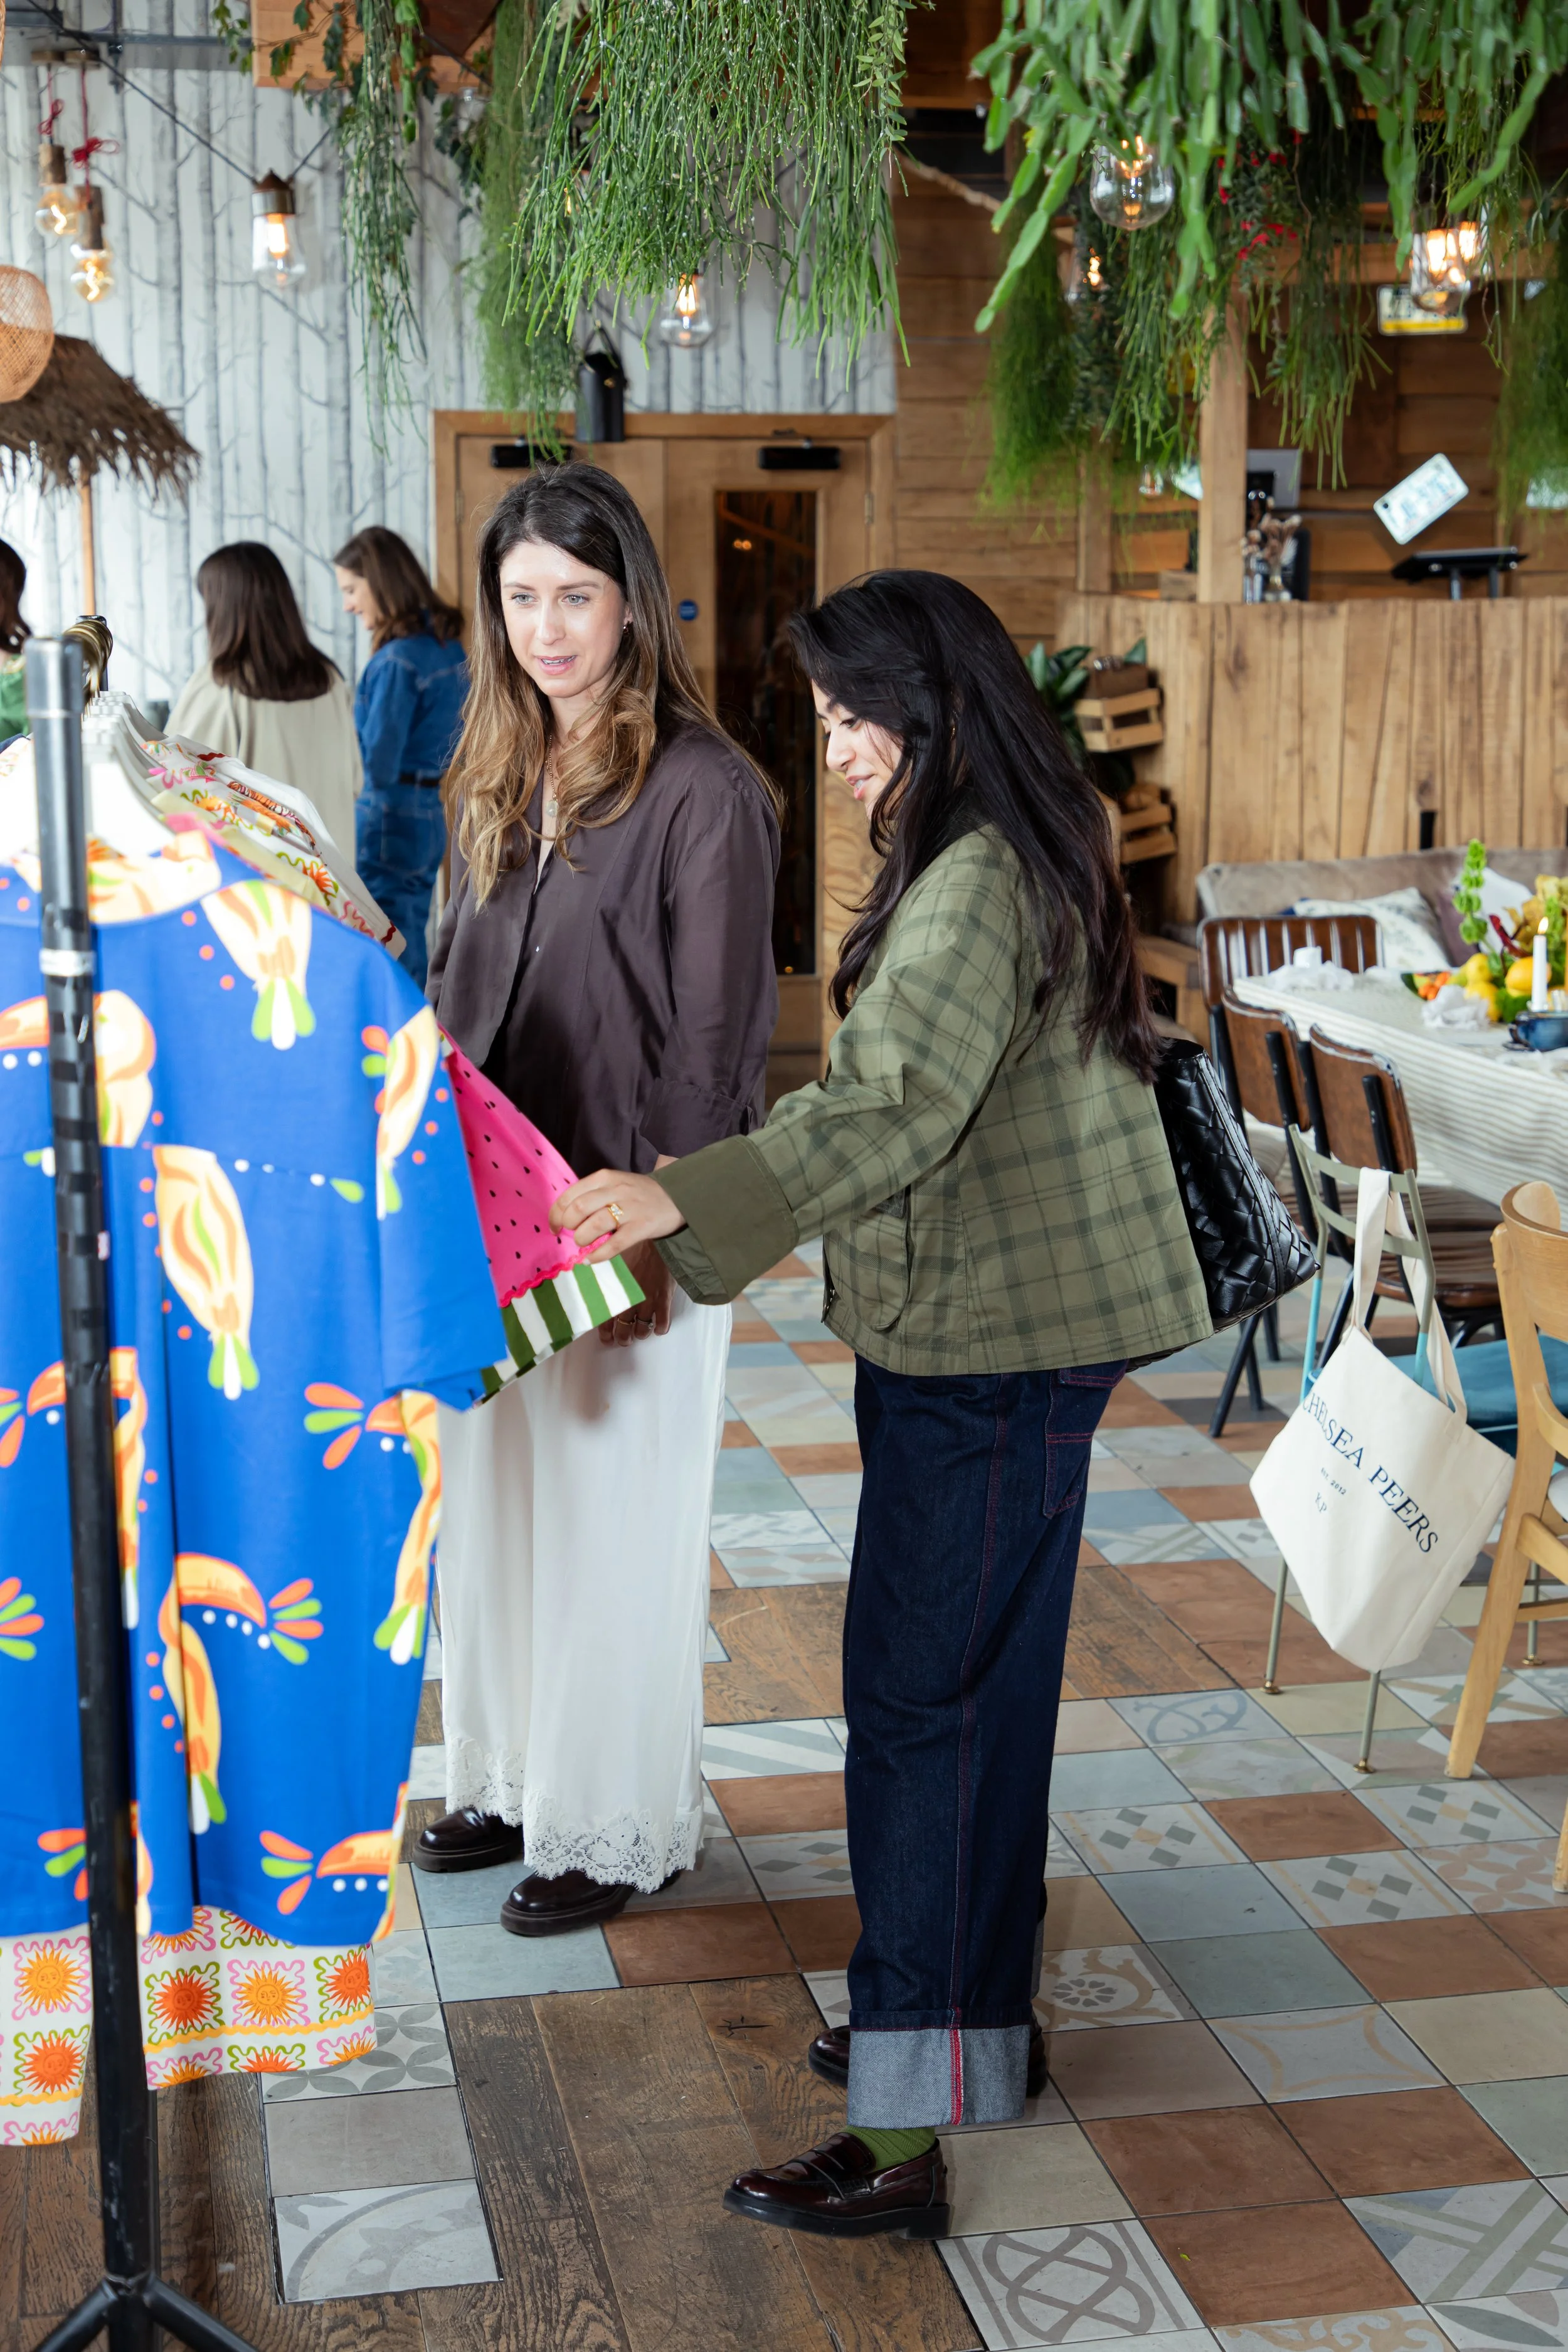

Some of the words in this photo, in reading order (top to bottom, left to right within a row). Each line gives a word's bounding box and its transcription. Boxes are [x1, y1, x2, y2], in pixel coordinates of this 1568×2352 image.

[1303, 1392, 1364, 1470] CHELSEA
[1368, 1465, 1438, 1553] PEERS
[1330, 1480, 1347, 1495] 2012
